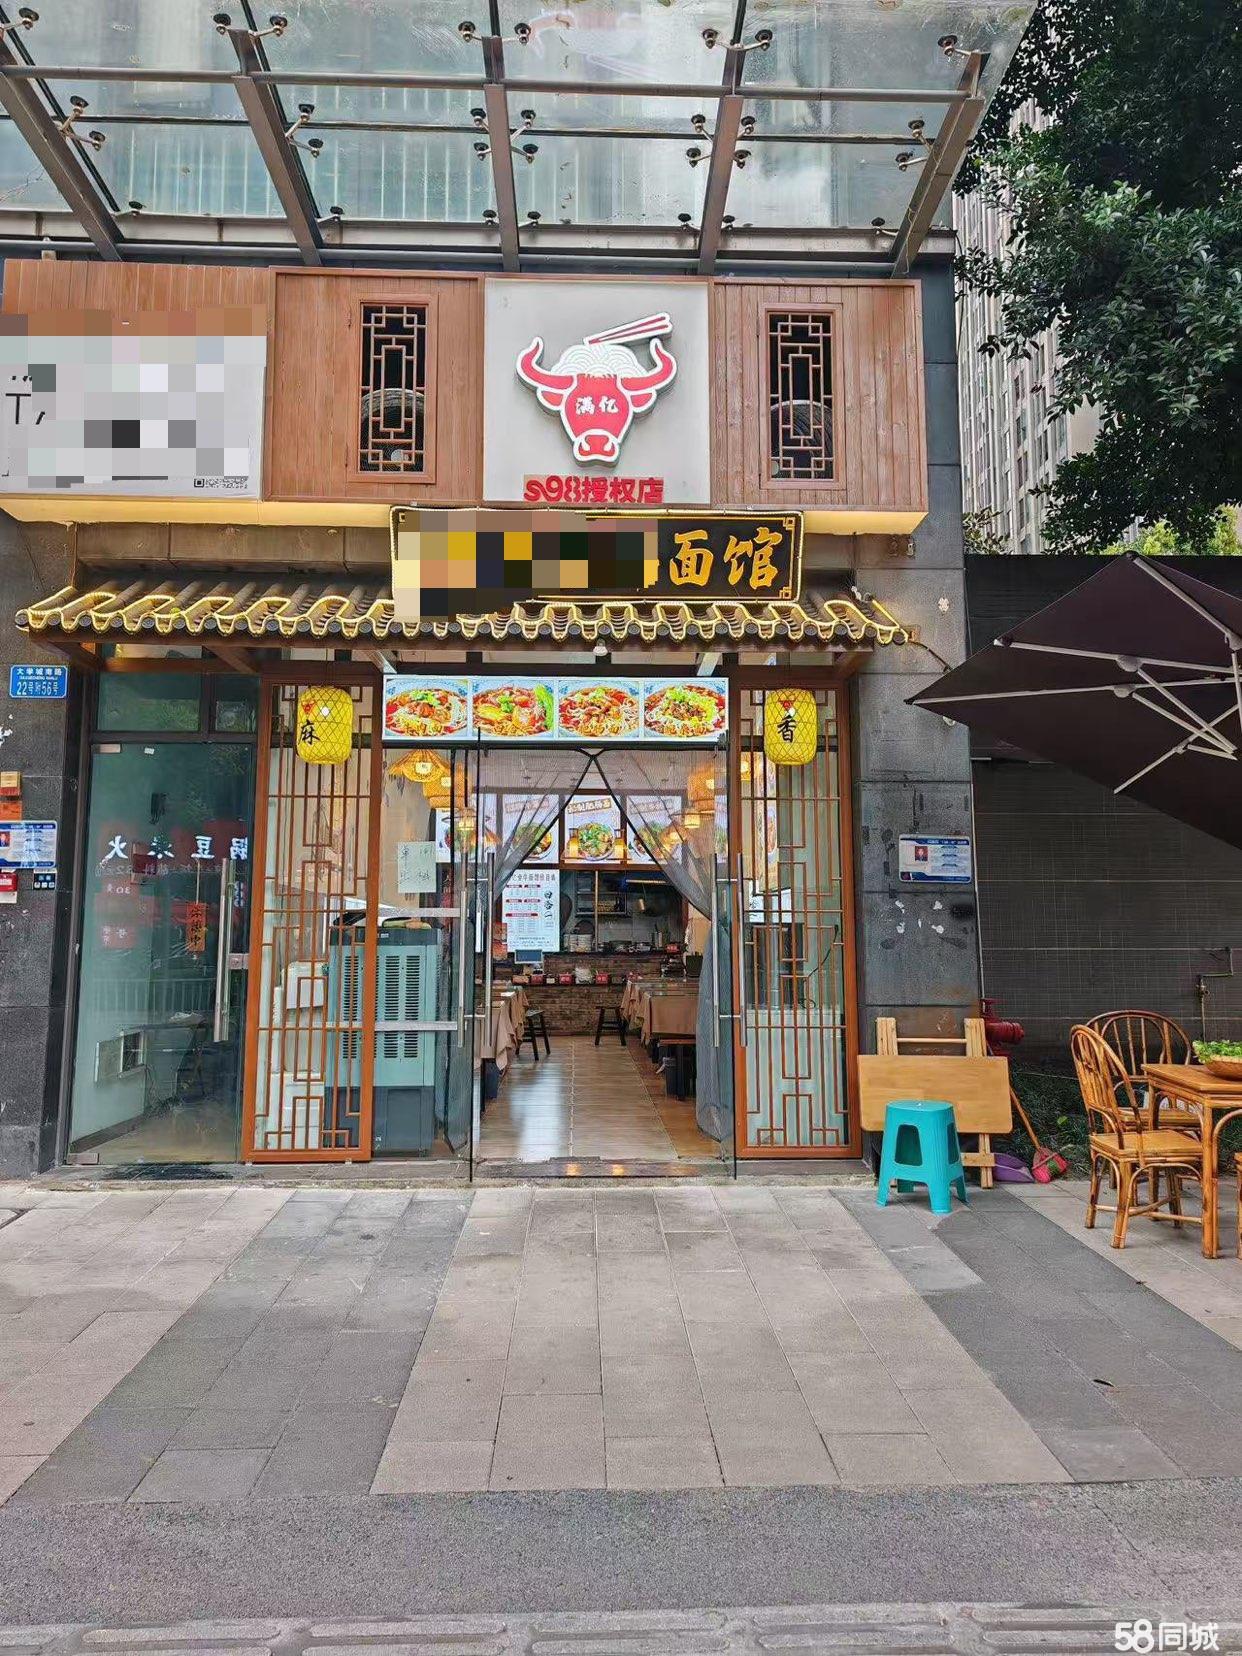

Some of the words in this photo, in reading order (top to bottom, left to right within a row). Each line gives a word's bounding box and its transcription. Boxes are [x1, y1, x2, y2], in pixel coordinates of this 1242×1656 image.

[575, 395, 619, 415] 满亿
[669, 526, 783, 590] 面馆
[16, 681, 59, 696] 22号附56号
[777, 715, 797, 743] 香
